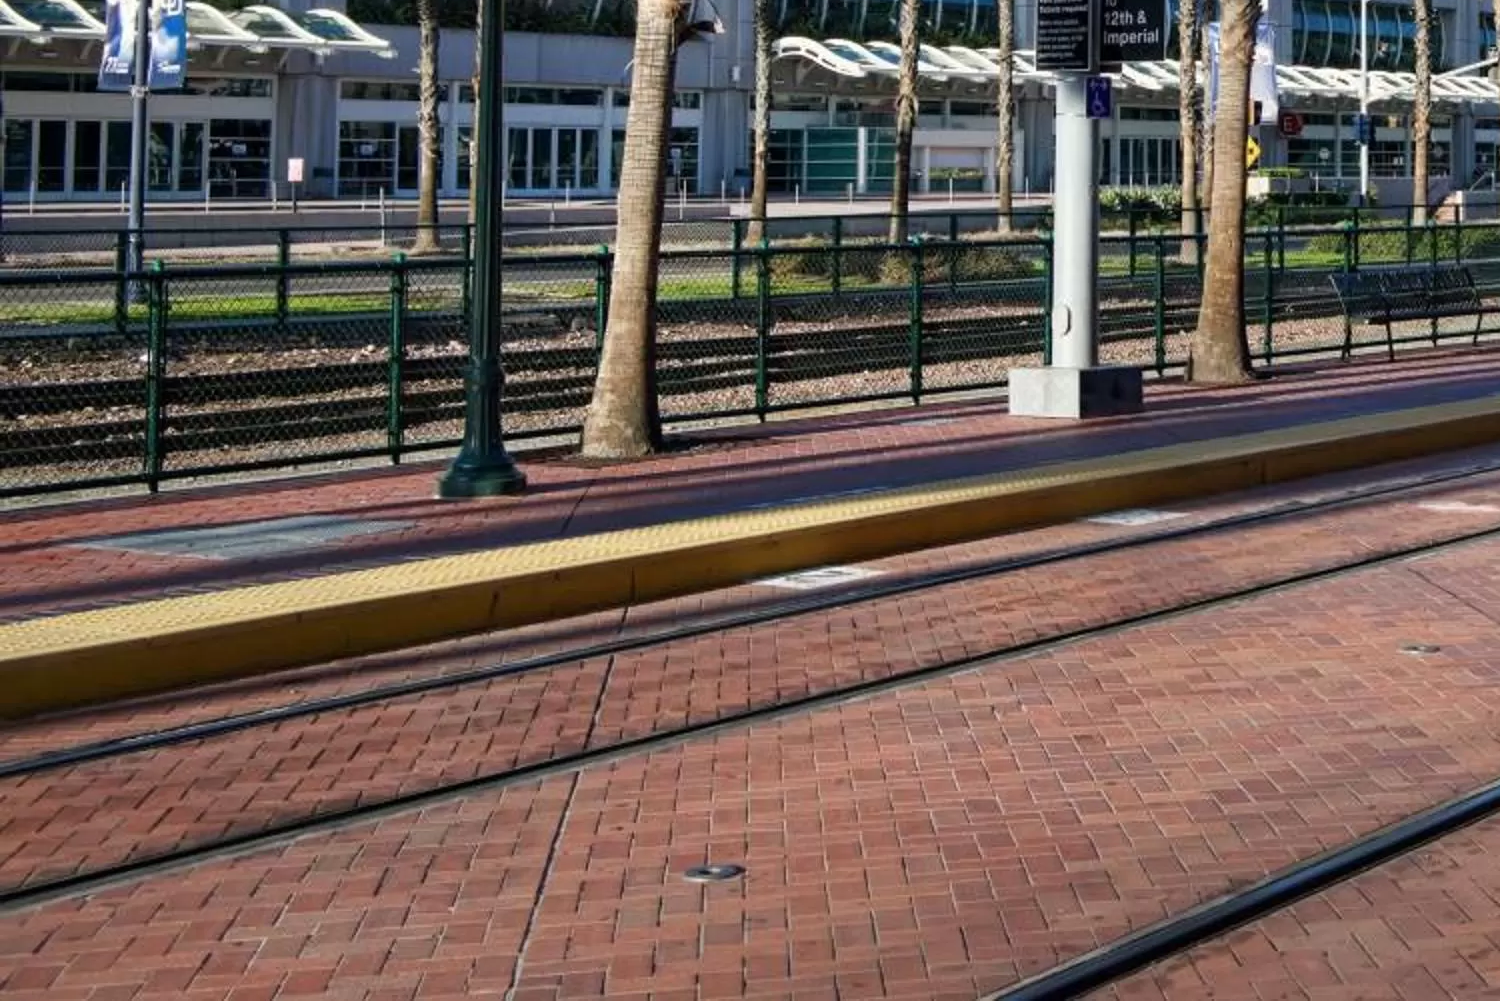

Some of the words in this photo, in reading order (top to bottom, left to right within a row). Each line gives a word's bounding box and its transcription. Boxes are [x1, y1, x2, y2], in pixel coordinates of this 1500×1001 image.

[1104, 9, 1133, 26] 12th
[1136, 9, 1147, 25] &
[1103, 27, 1159, 47] Imperial
